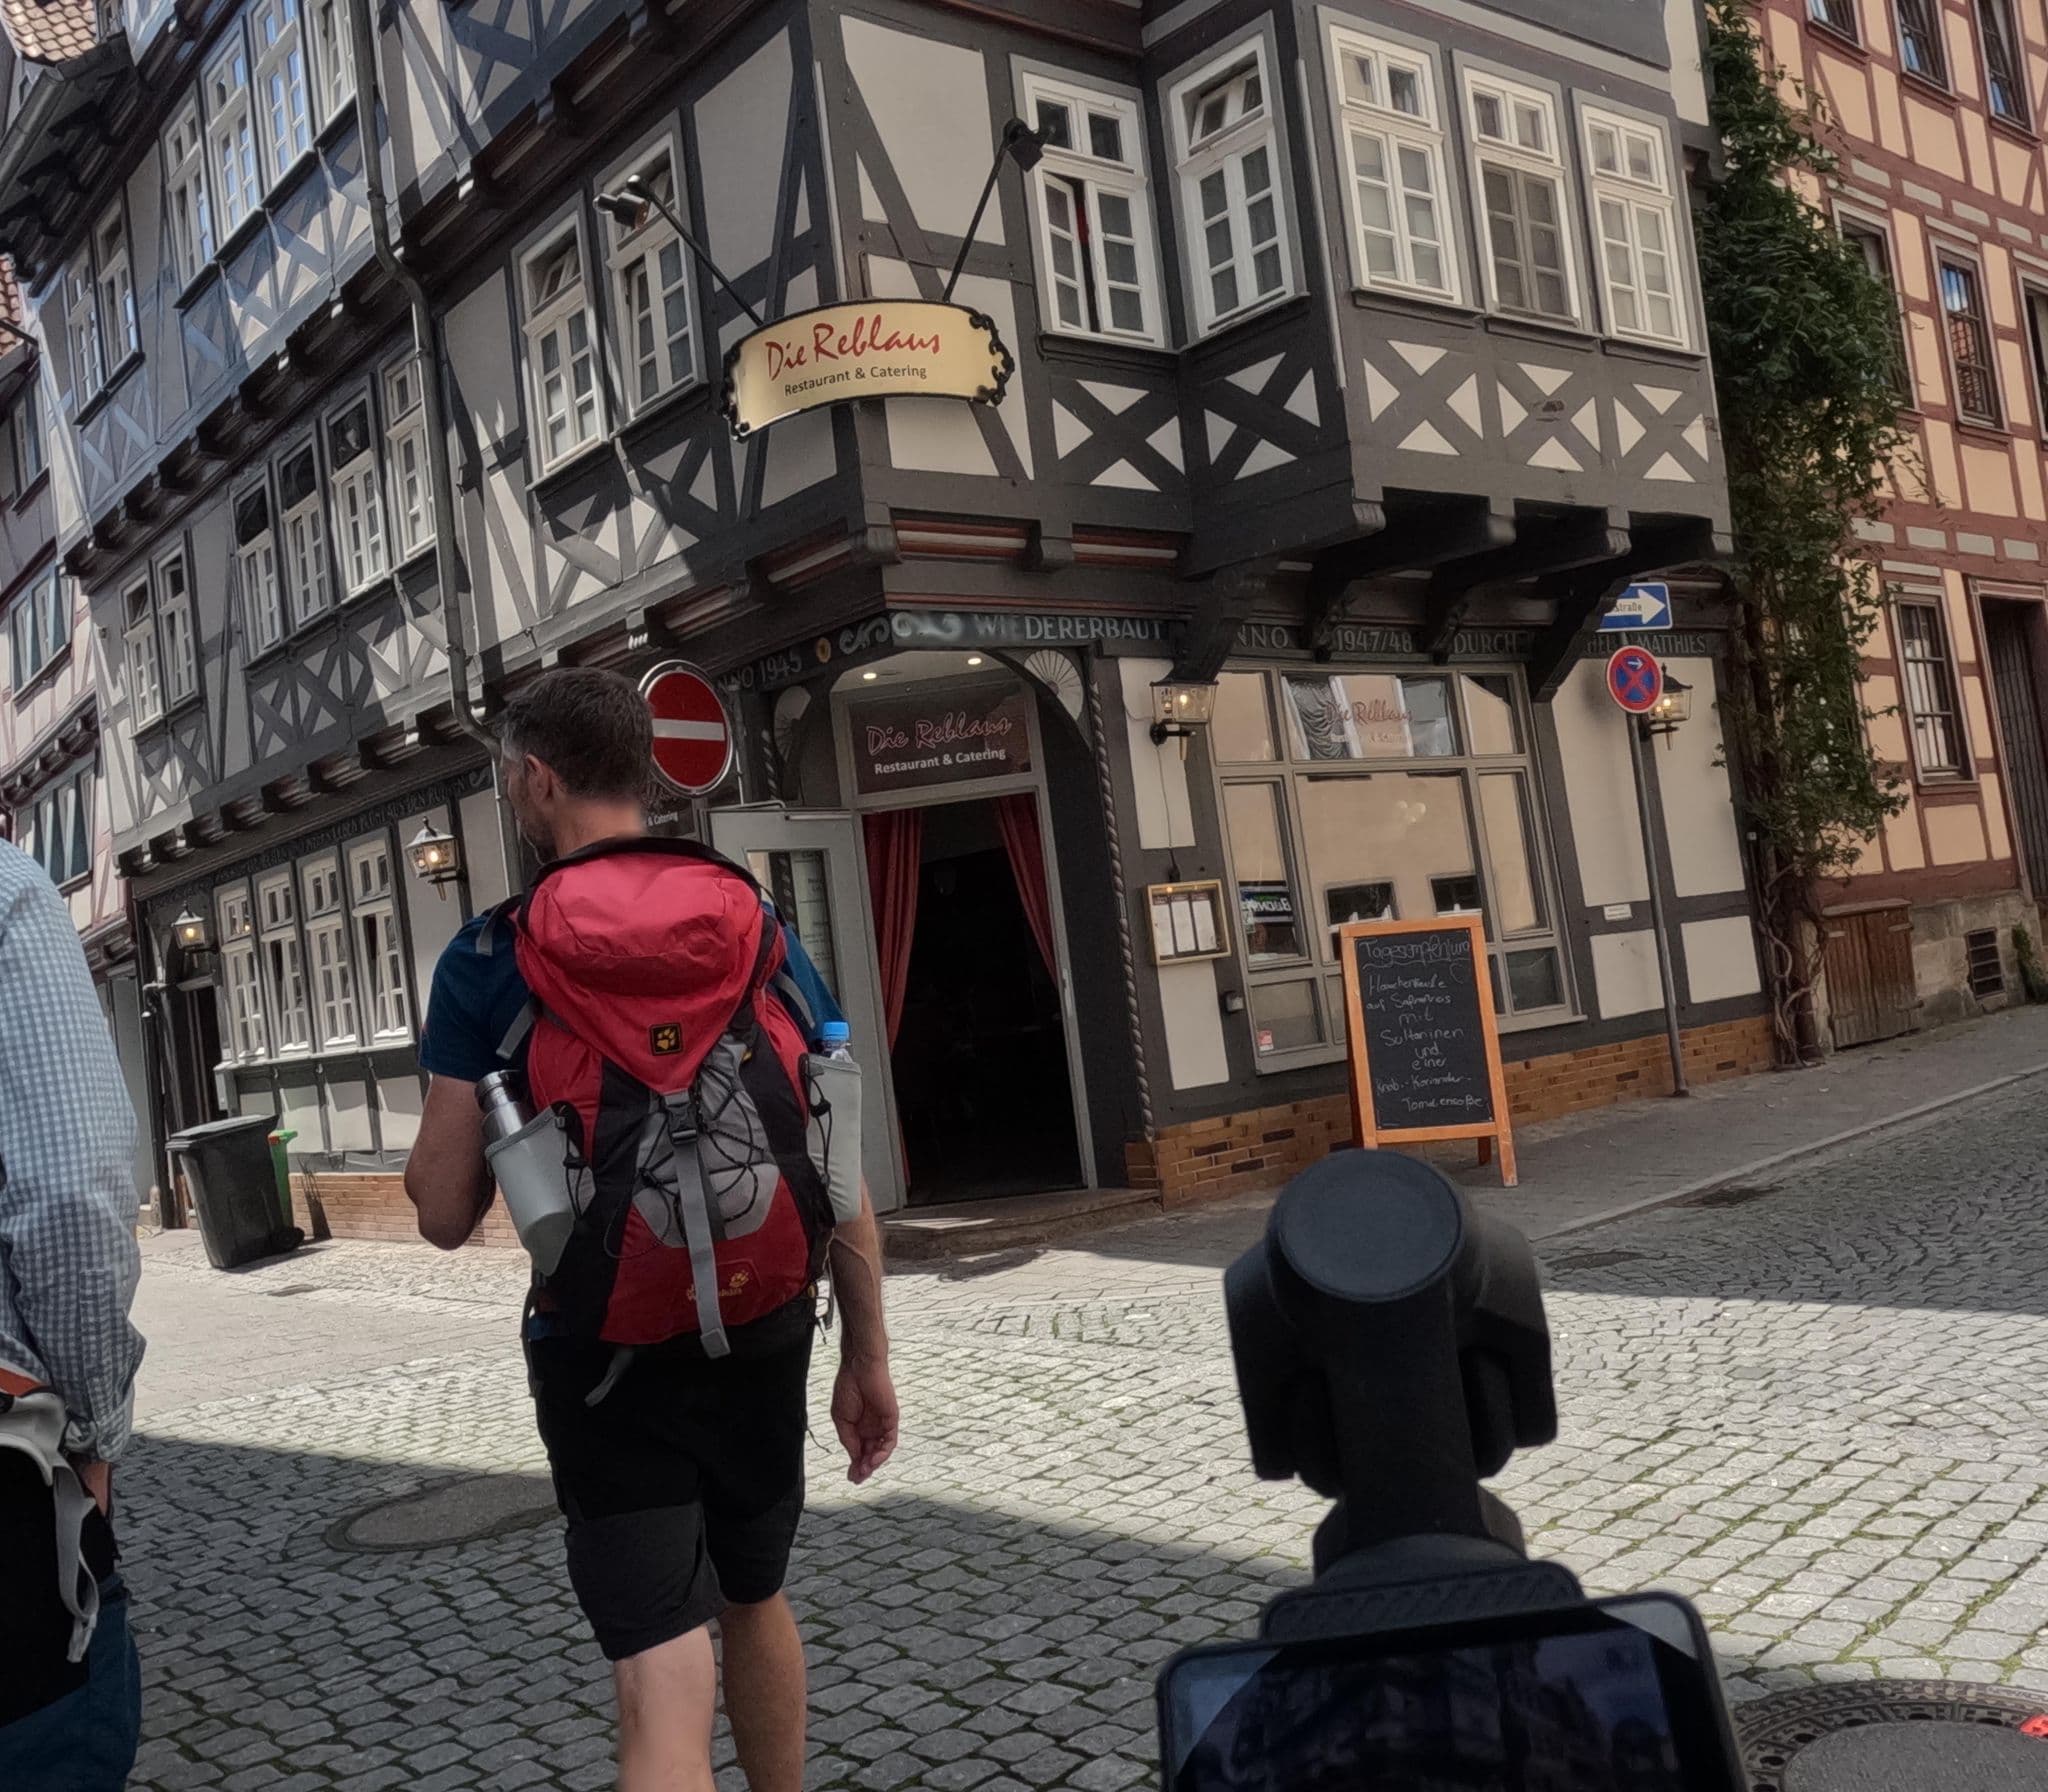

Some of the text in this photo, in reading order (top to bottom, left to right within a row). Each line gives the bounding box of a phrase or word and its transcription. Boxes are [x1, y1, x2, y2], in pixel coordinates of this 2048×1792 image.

[765, 314, 941, 382] Die Reblaus
[784, 364, 928, 397] Restaurant & Catering
[974, 614, 1165, 640] WIDERERBAUT
[1237, 624, 1289, 649] NNO
[1336, 628, 1413, 653] 1947/48
[759, 650, 802, 684] 1945
[866, 712, 1013, 757] Die Reblaus
[874, 748, 1007, 775] Restaurant & Catering
[1415, 1042, 1440, 1058] und
